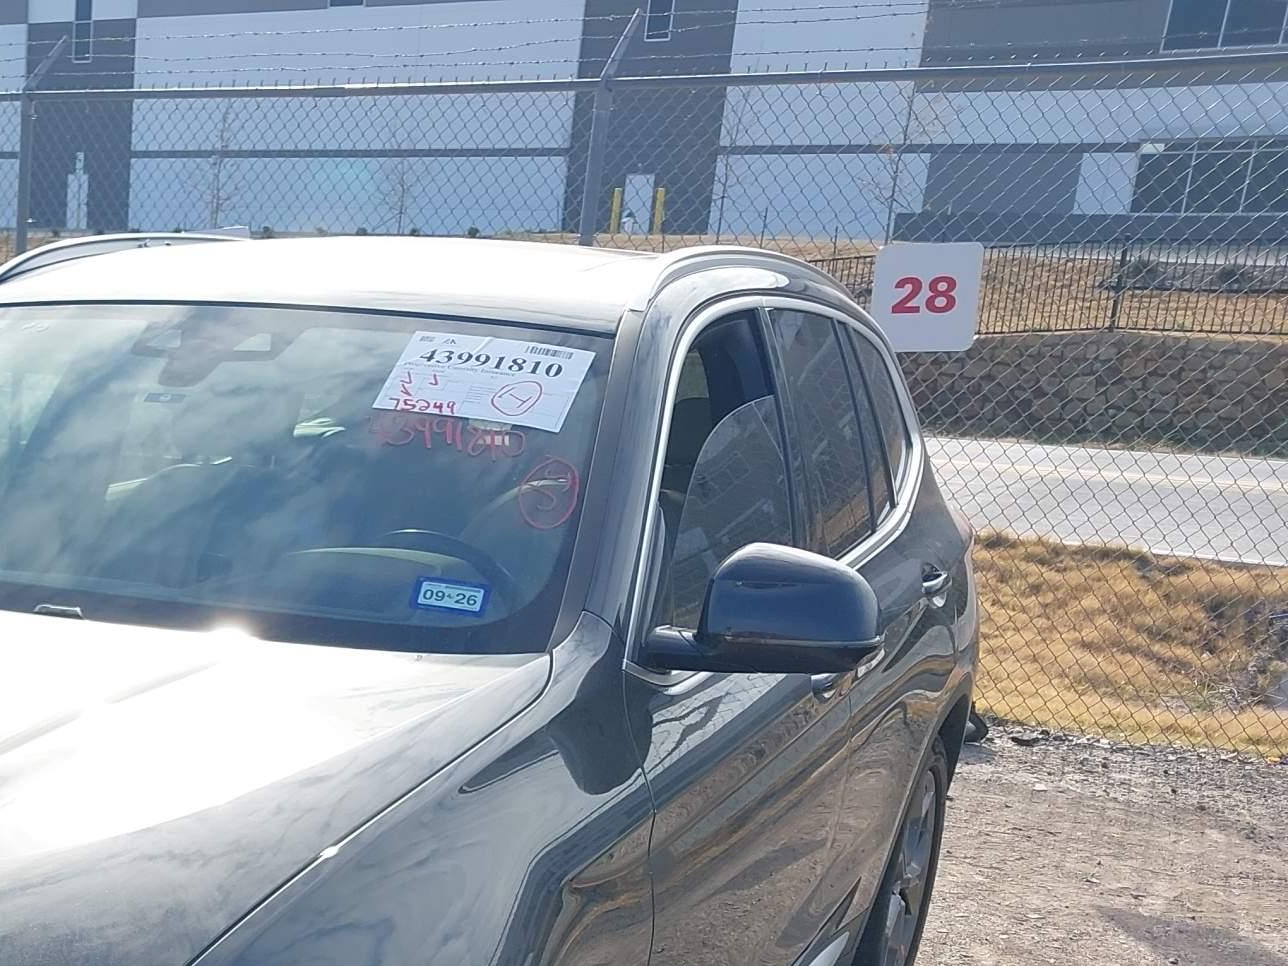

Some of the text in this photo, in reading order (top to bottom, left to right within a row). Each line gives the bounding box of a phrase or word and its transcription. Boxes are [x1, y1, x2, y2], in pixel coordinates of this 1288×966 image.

[890, 275, 958, 314] 28
[419, 348, 564, 378] 43991810
[422, 588, 479, 606] 09 26
